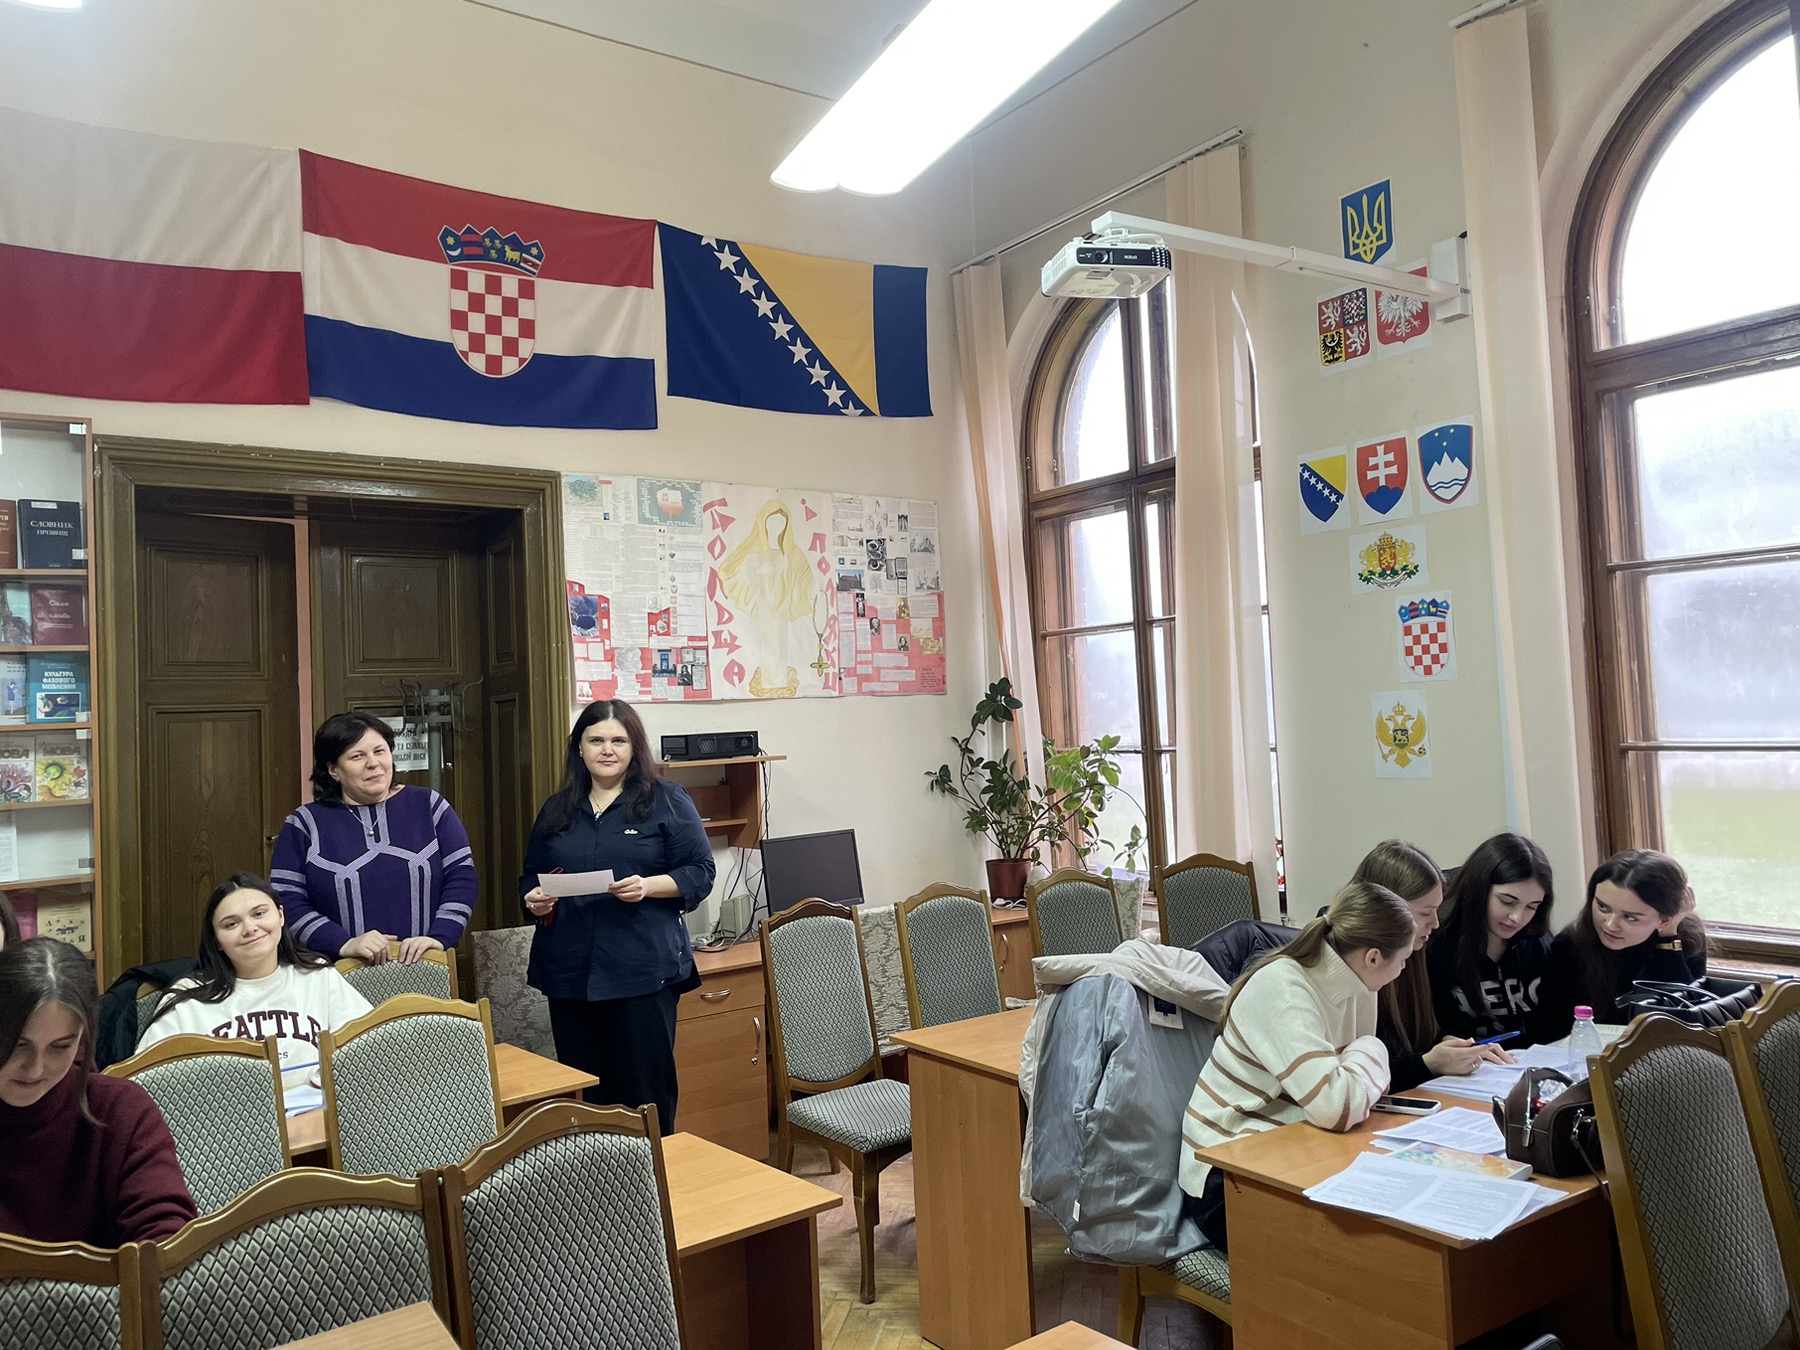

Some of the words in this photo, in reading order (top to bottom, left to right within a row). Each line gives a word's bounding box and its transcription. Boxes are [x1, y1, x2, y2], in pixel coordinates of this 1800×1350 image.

[30, 520, 74, 529] СЛОВНИК
[0, 748, 29, 759] ОВА
[211, 1010, 321, 1049] EATTLE
